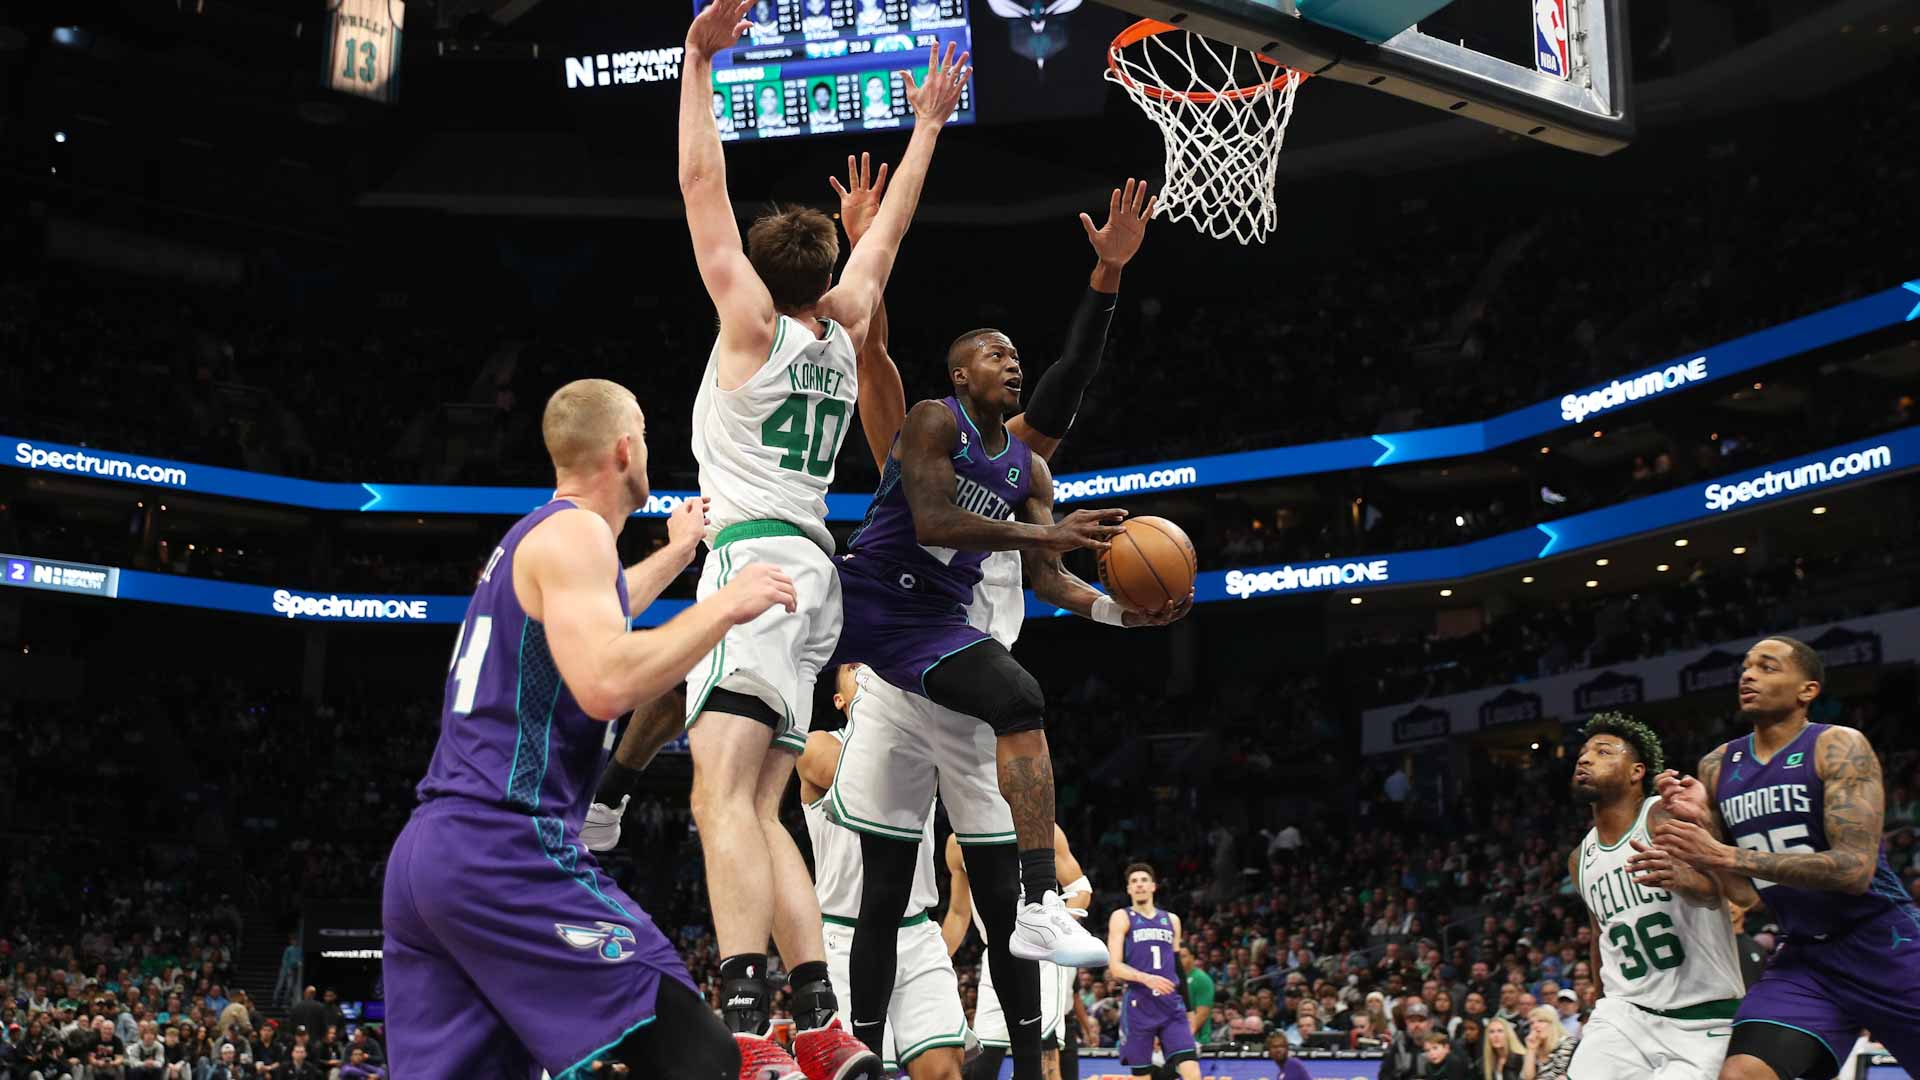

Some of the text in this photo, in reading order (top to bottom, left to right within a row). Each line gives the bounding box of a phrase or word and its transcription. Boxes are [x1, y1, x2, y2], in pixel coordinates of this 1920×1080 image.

[343, 38, 376, 83] 13
[612, 47, 684, 69] NOVANT
[613, 63, 679, 85] HEALTH
[1540, 52, 1557, 71] NBA
[788, 363, 845, 397] KORNET
[761, 392, 846, 478] 40
[960, 431, 968, 445] 6
[15, 442, 187, 486] Spectrum.com
[1705, 446, 1892, 511] Spectrum.com
[1052, 465, 1197, 503] Spectrum.com
[11, 563, 25, 580] 2
[1731, 751, 1743, 763] 6
[1719, 783, 1813, 829] HORNETS
[1150, 945, 1162, 970] 1
[1608, 912, 1686, 981] 36
